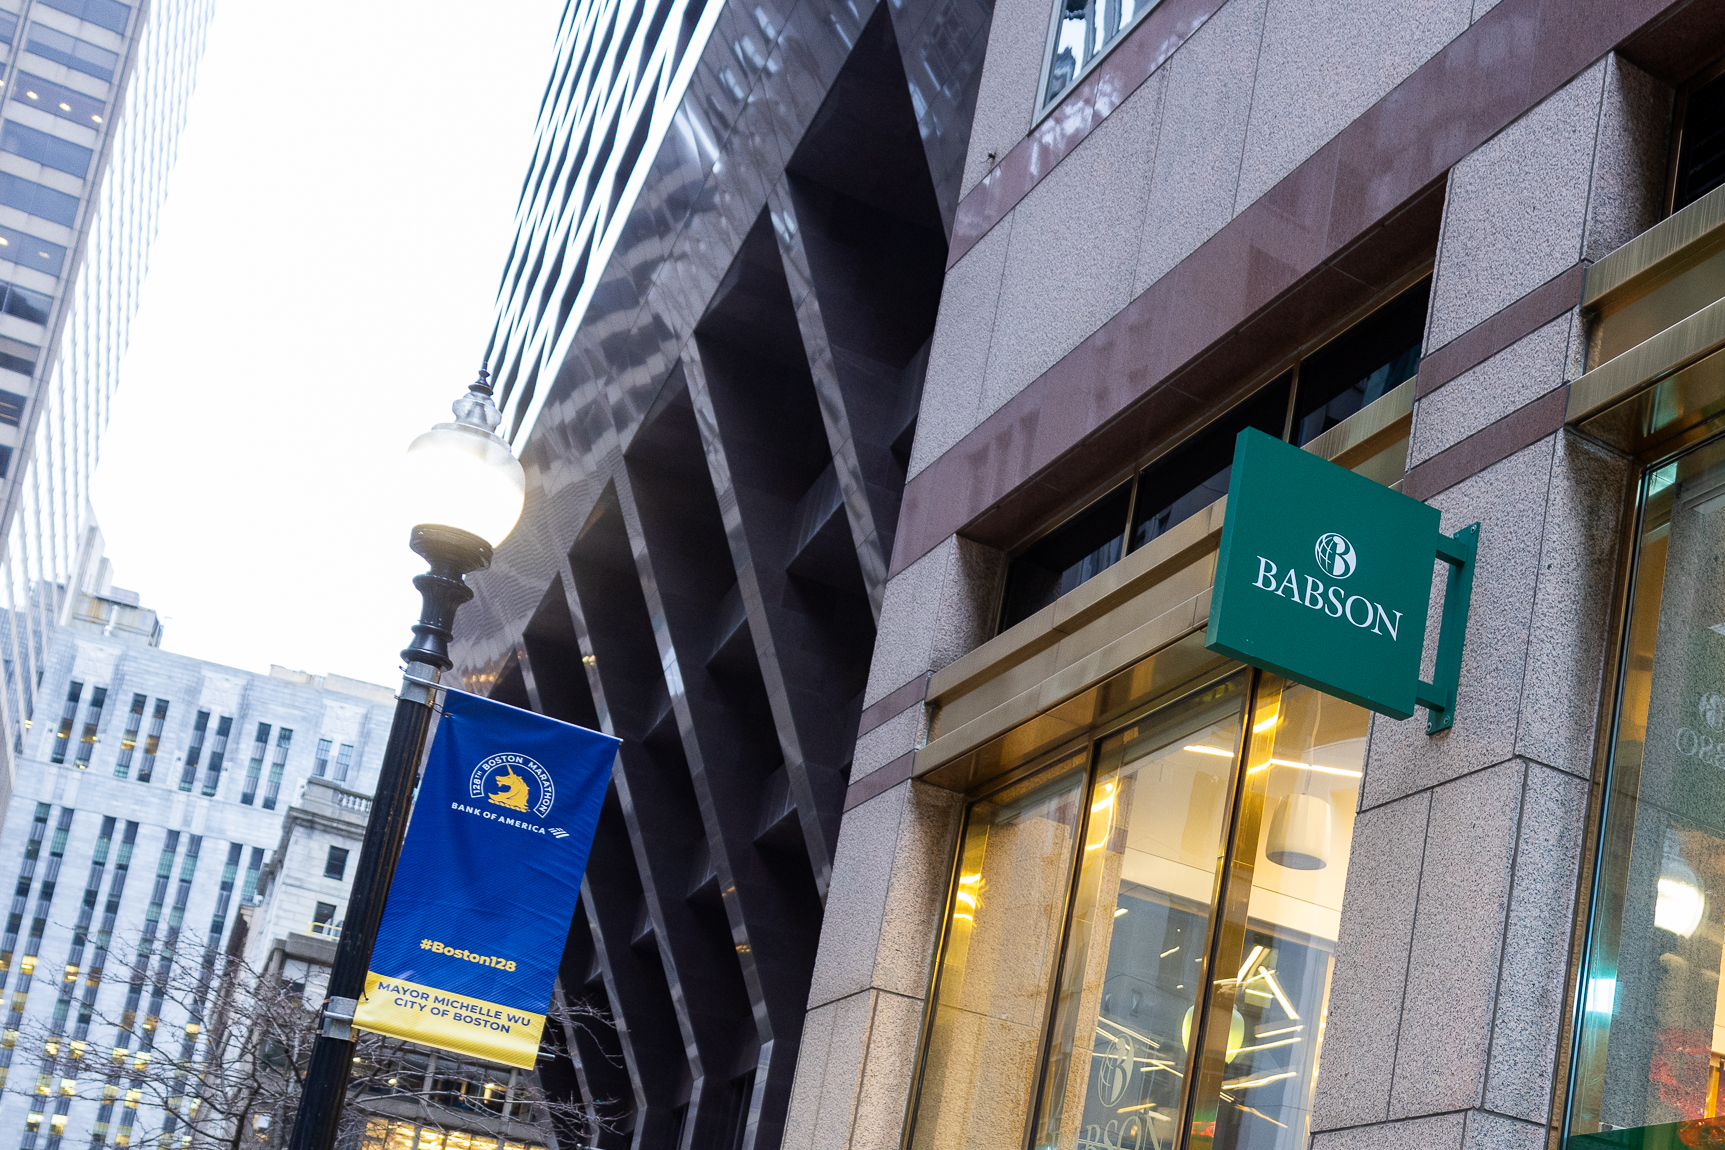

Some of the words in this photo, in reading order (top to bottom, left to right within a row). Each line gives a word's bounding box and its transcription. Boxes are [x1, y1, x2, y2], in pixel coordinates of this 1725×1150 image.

[1252, 556, 1403, 641] BABSON
[482, 755, 523, 771] BOSTON
[528, 762, 552, 813] MARATHON
[451, 802, 481, 816] BANK
[482, 811, 497, 820] OF
[498, 816, 546, 835] AMERICA
[420, 938, 517, 973] #Boston128
[378, 981, 429, 1002] MAYOR
[433, 995, 503, 1021] MICHELLE
[506, 1012, 532, 1027] WU
[394, 996, 427, 1013] CITY
[430, 1006, 450, 1019] OF
[453, 1011, 511, 1034] BOSTON
